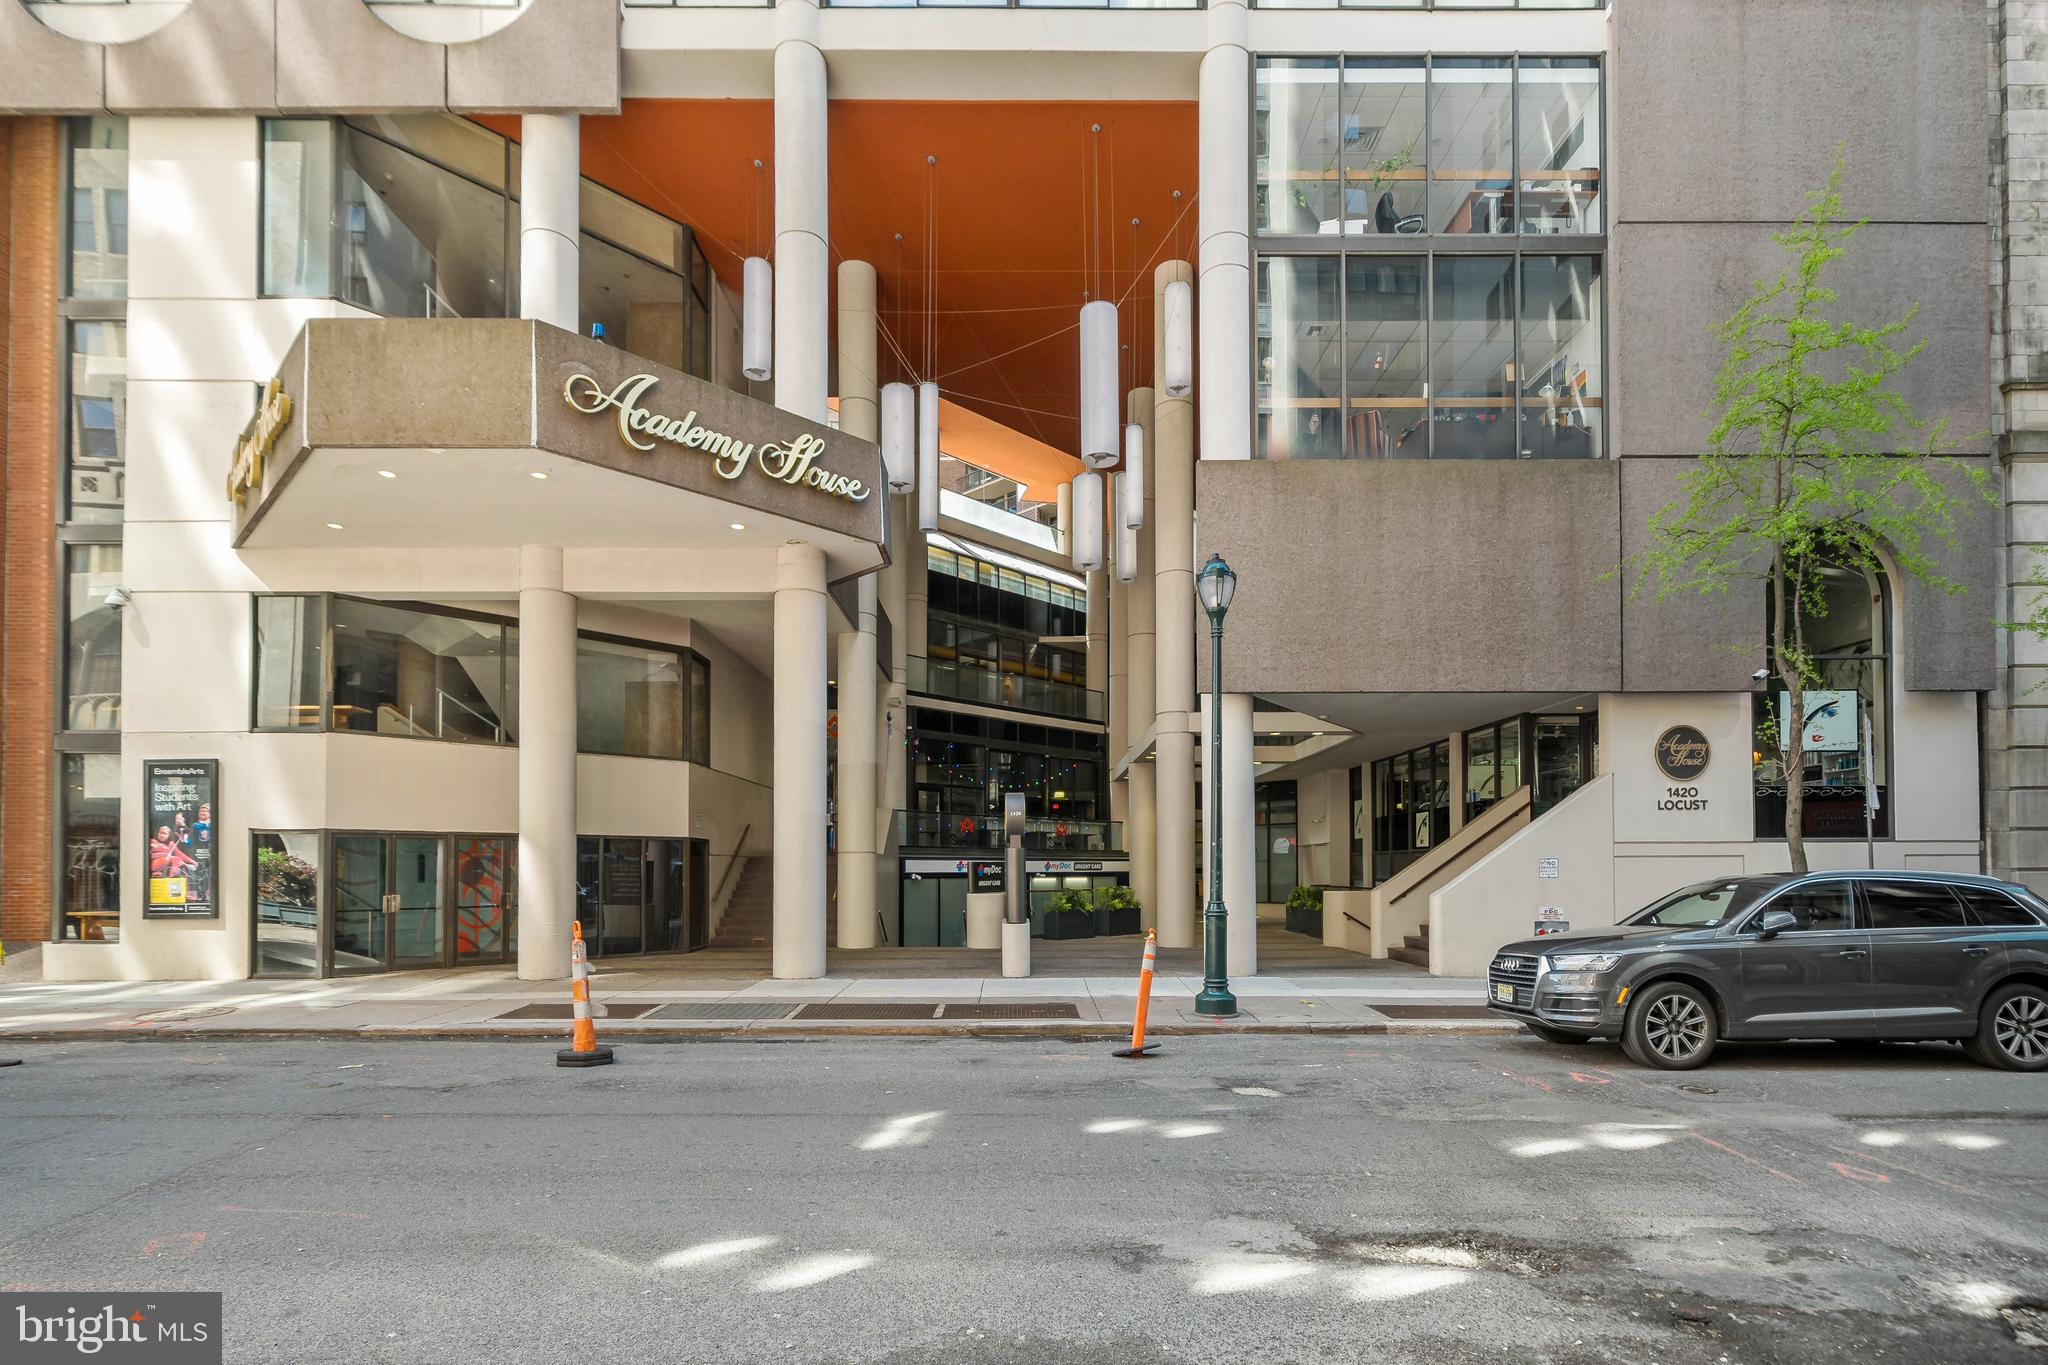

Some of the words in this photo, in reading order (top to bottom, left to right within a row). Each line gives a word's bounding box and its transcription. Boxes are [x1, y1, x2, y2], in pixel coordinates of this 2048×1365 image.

[563, 373, 754, 480] Academy
[758, 433, 871, 501] House
[1658, 734, 1709, 758] Academy
[1667, 749, 1707, 767] House
[153, 767, 205, 775] EnsembleArts
[154, 782, 197, 794] Inspiring
[1666, 787, 1699, 798] 1420
[154, 792, 200, 802] Students
[154, 801, 175, 811] with
[176, 801, 193, 811] Art
[1657, 799, 1709, 811] LOCUST
[984, 864, 1002, 876] myDoc
[1051, 862, 1072, 870] myDoc
